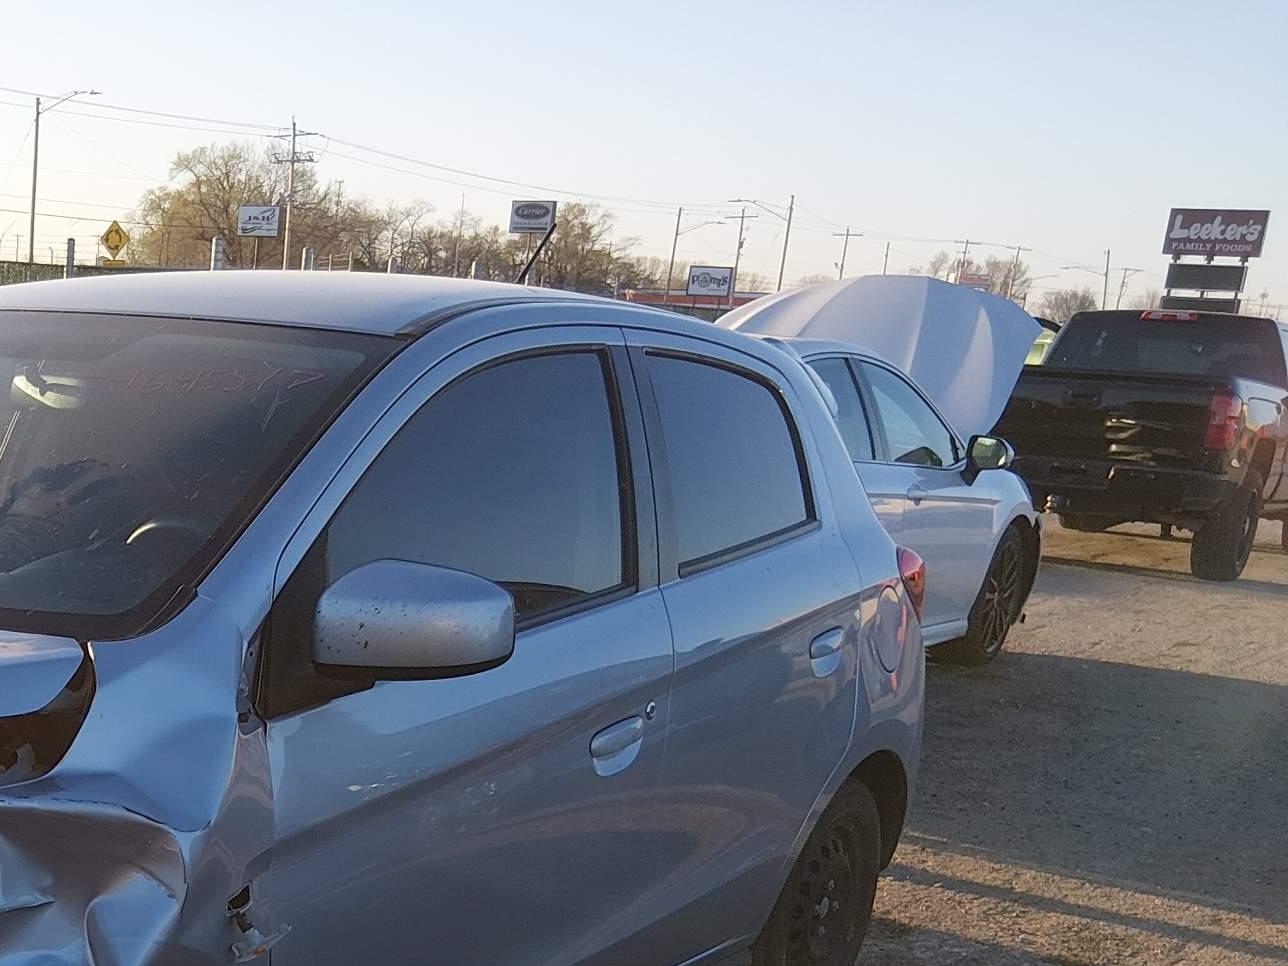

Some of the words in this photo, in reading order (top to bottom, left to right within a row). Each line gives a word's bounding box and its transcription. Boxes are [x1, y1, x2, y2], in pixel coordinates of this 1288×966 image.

[1169, 214, 1262, 241] Leeker's
[1172, 242, 1212, 251] FAMILY
[1215, 243, 1253, 252] FOODS
